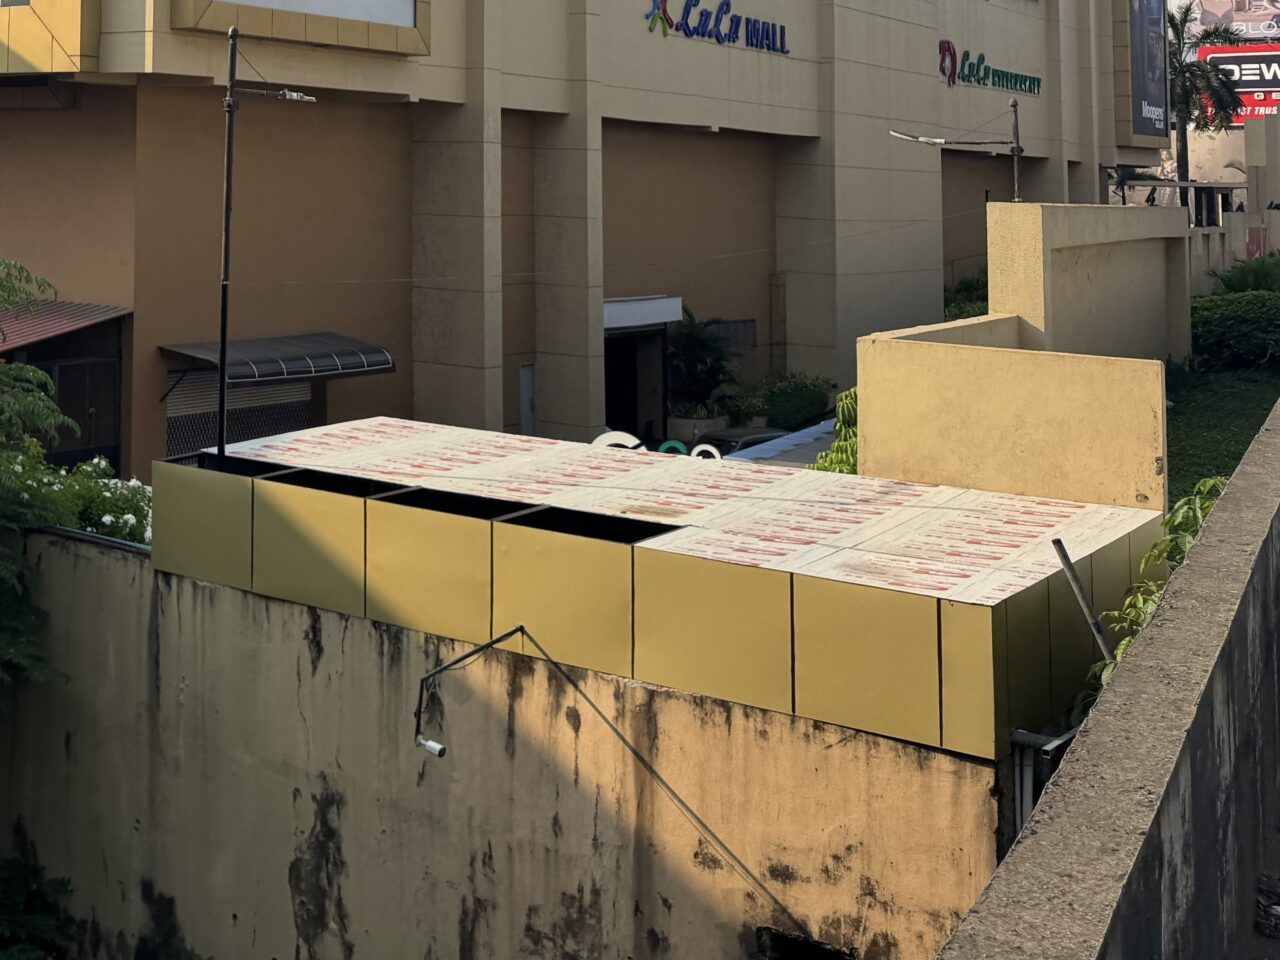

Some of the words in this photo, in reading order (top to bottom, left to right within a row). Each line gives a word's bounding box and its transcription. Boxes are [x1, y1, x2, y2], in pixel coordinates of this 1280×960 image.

[745, 17, 789, 54] MALL
[957, 50, 991, 86] LuLu
[1255, 106, 1277, 115] TRUS
